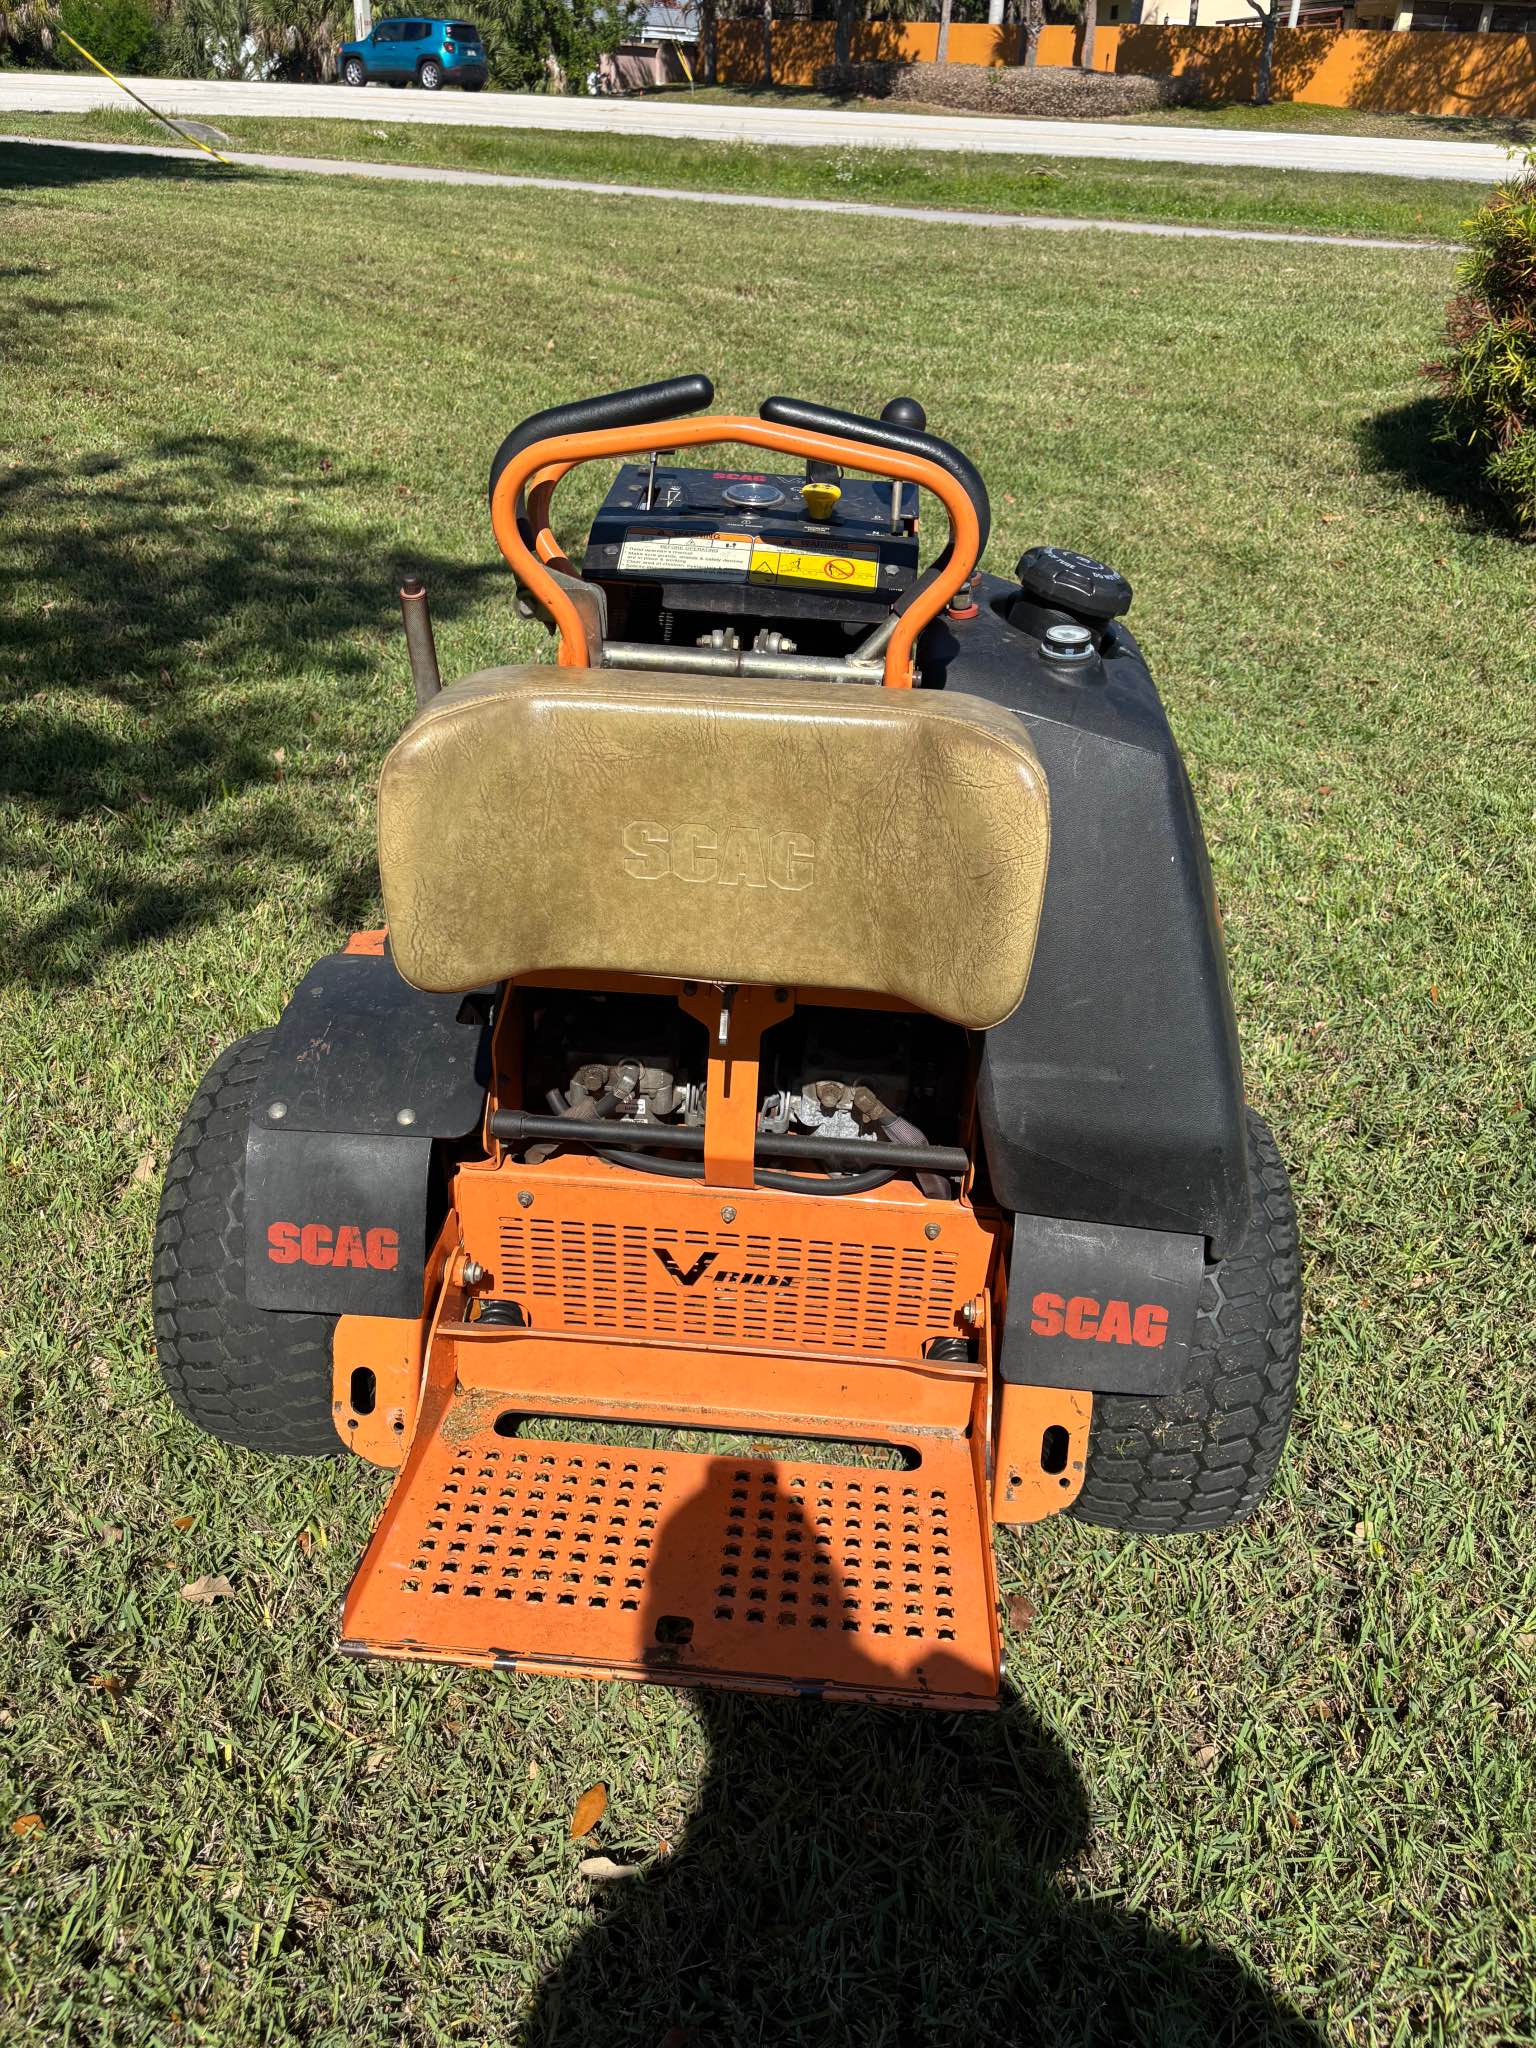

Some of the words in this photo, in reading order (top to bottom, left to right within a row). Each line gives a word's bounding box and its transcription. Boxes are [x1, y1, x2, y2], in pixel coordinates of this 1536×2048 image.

[713, 473, 767, 482] SCAG
[623, 819, 816, 891] SCAG
[267, 1221, 399, 1270] SCAG
[1030, 1292, 1169, 1348] SCAG
